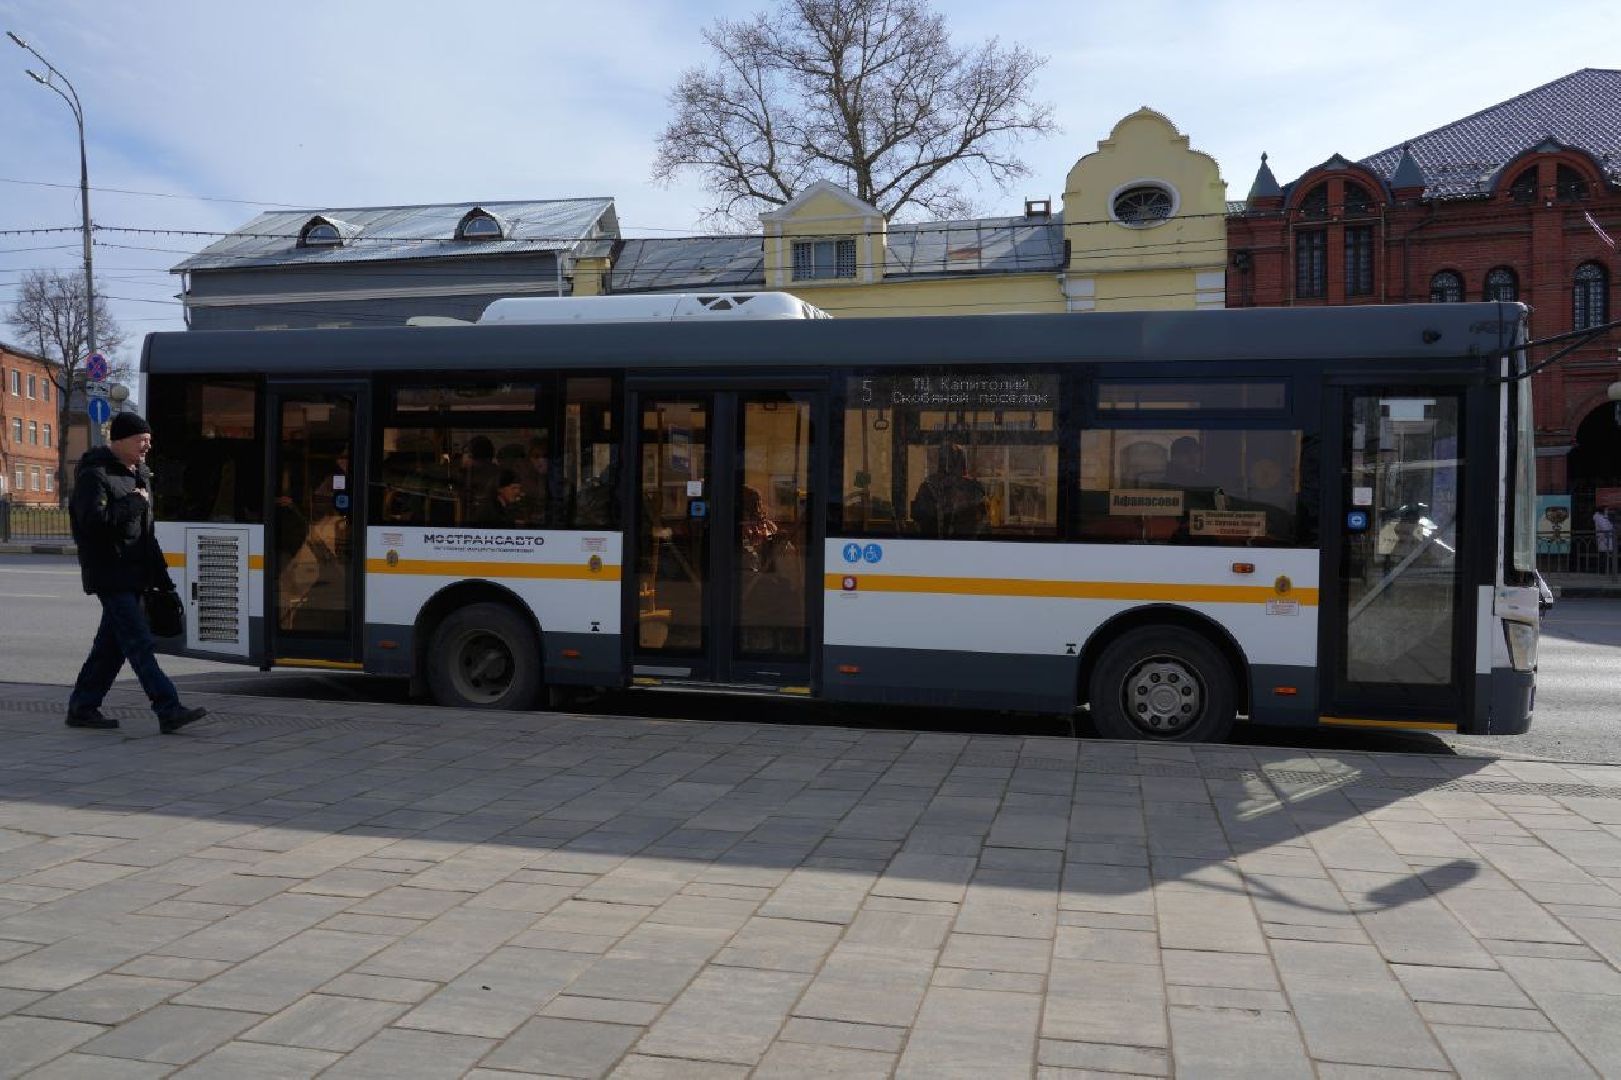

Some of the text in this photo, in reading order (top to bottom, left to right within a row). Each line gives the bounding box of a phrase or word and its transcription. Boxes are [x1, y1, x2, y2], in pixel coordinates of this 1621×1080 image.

[862, 378, 872, 402] 5
[1193, 514, 1204, 531] 5
[424, 534, 545, 546] МОСТРАНСАВТО
